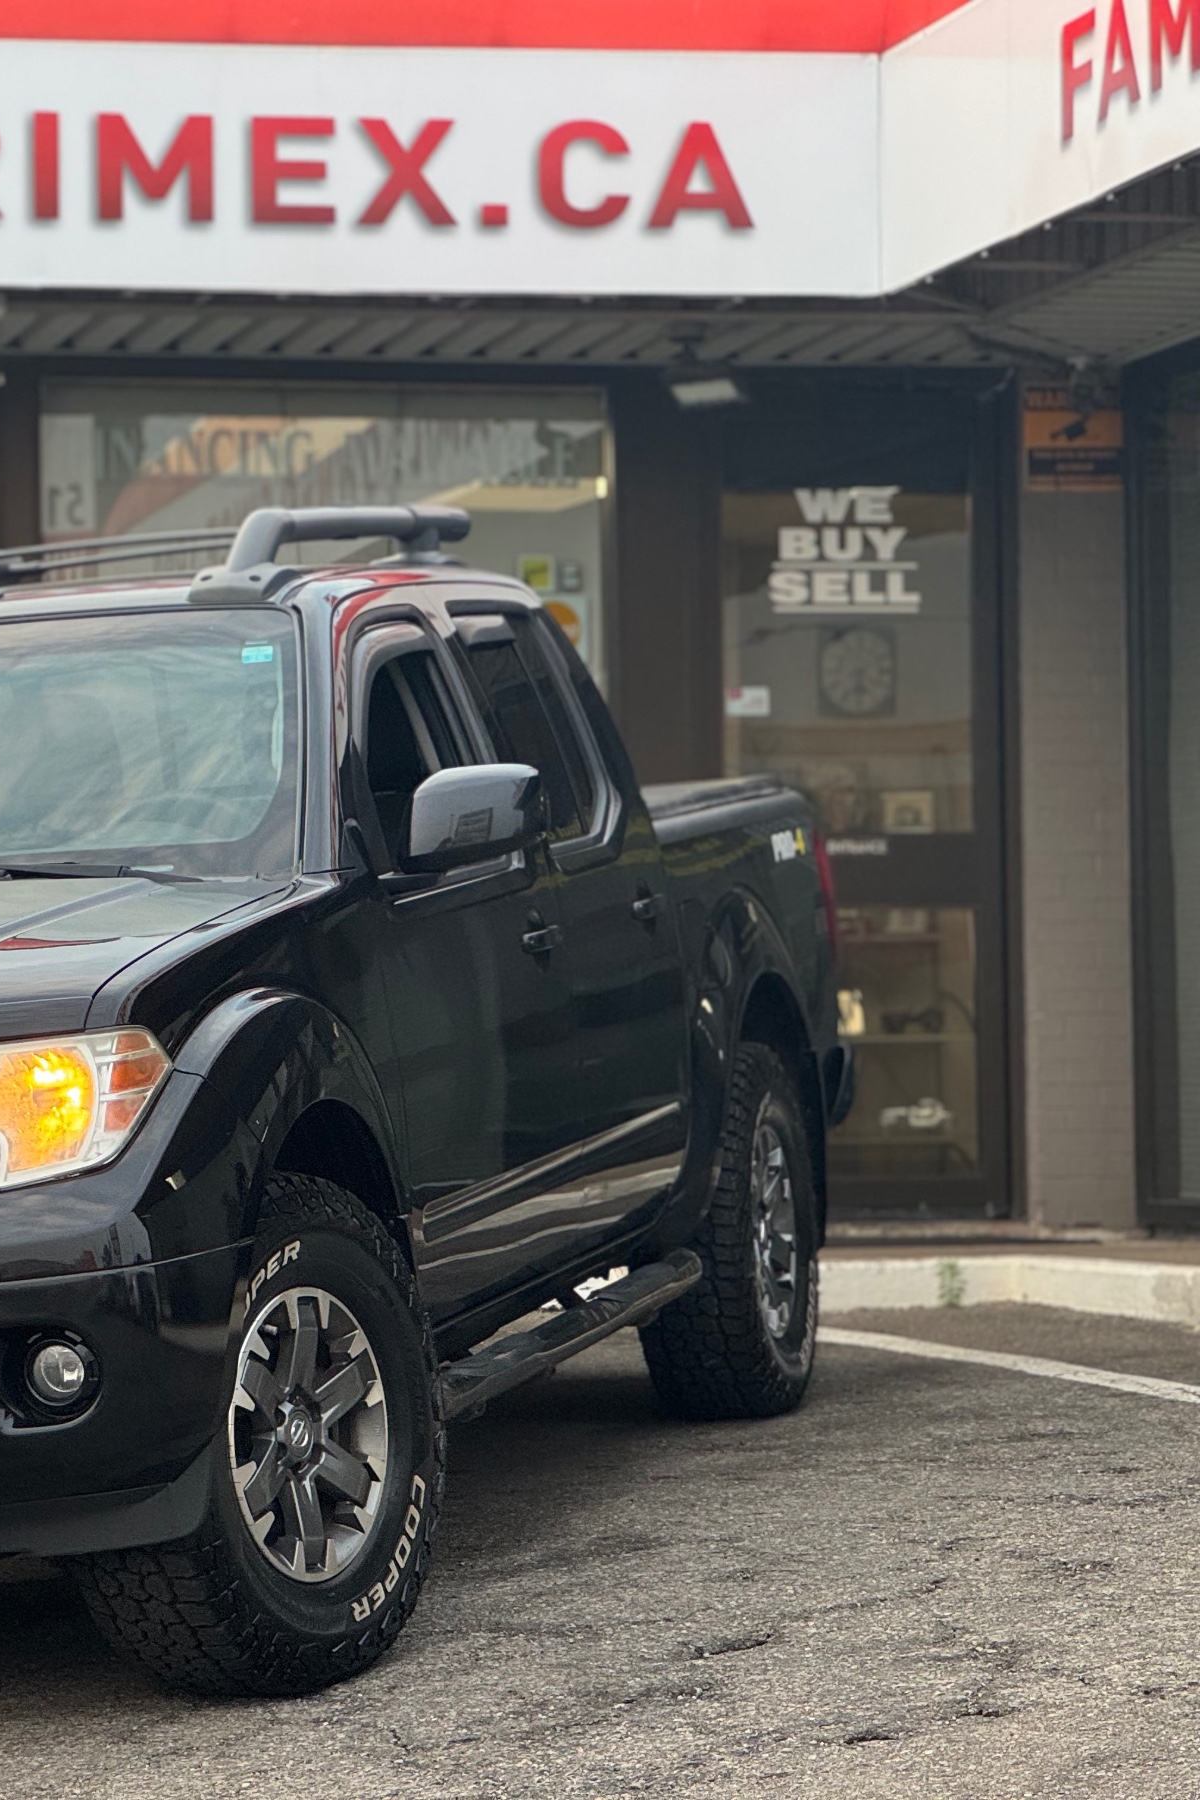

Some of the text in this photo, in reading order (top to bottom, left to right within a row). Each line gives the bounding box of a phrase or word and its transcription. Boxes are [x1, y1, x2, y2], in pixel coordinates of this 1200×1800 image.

[1061, 0, 1200, 142] FAM
[795, 486, 899, 523] WE
[778, 527, 906, 561] BUY
[768, 570, 920, 604] SELL
[243, 1240, 300, 1318] PER
[350, 1474, 427, 1622] COOPER
